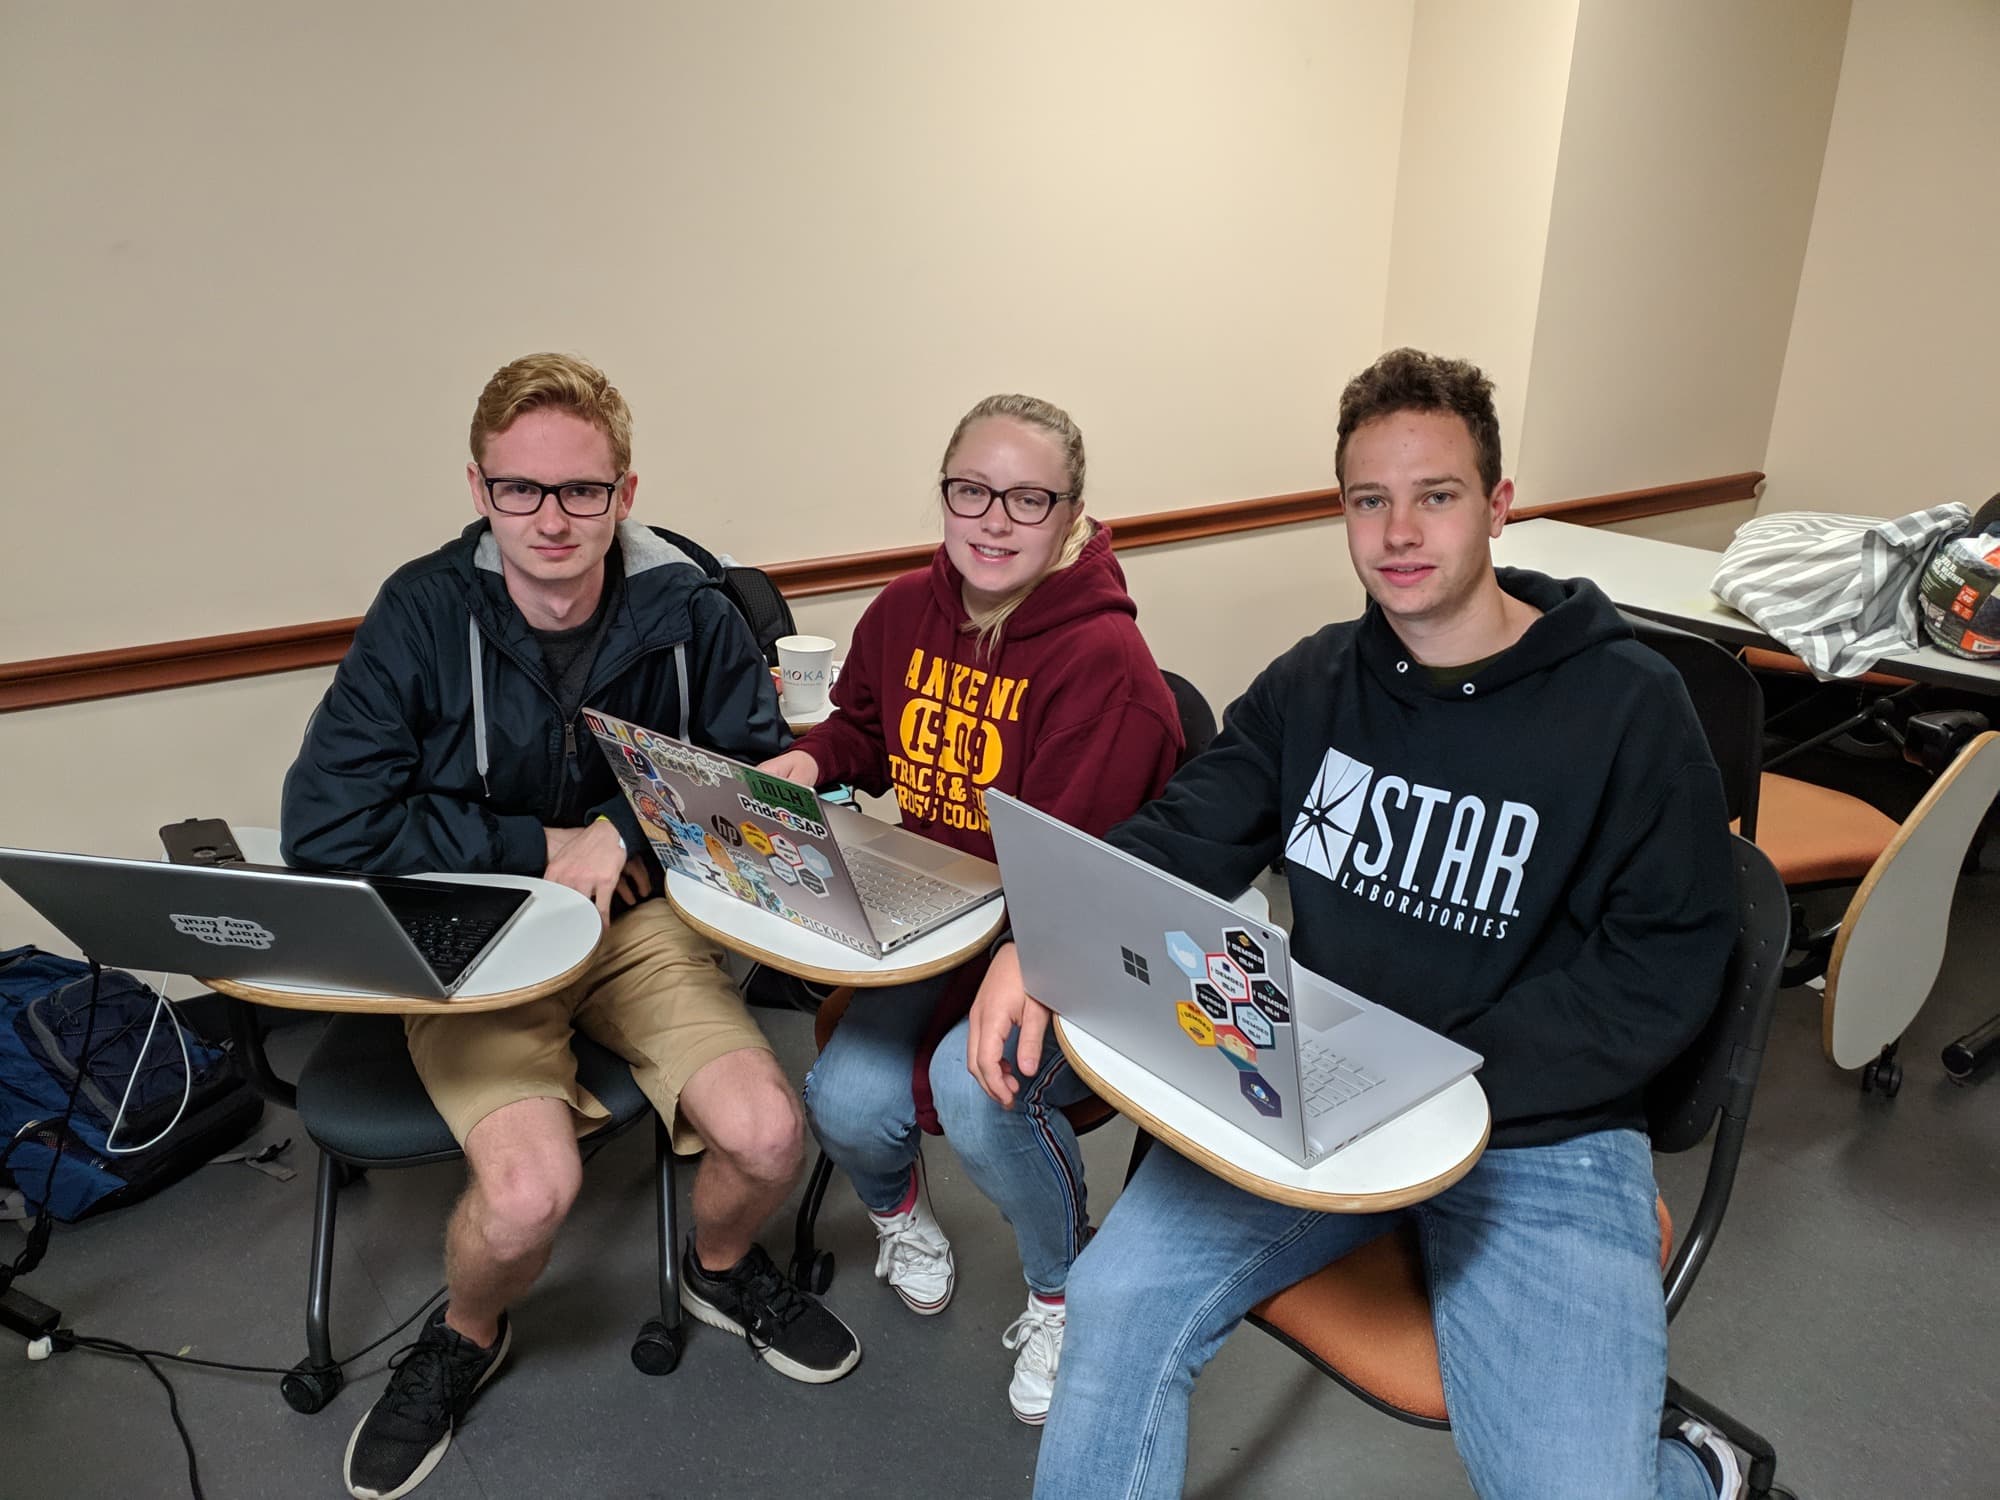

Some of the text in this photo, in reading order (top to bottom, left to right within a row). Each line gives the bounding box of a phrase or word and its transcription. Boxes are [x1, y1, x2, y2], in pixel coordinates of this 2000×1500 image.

[783, 668, 824, 681] MOKA
[759, 779, 804, 807] MLH
[889, 755, 946, 797] TRACK
[949, 777, 967, 802] &
[893, 783, 939, 821] ROSS
[714, 814, 741, 846] hp
[1341, 872, 1508, 939] LABORATORIES
[178, 918, 255, 930] day bruh
[183, 926, 268, 938] start your
[801, 915, 877, 956] PICKHACKS
[203, 935, 263, 946] time to
